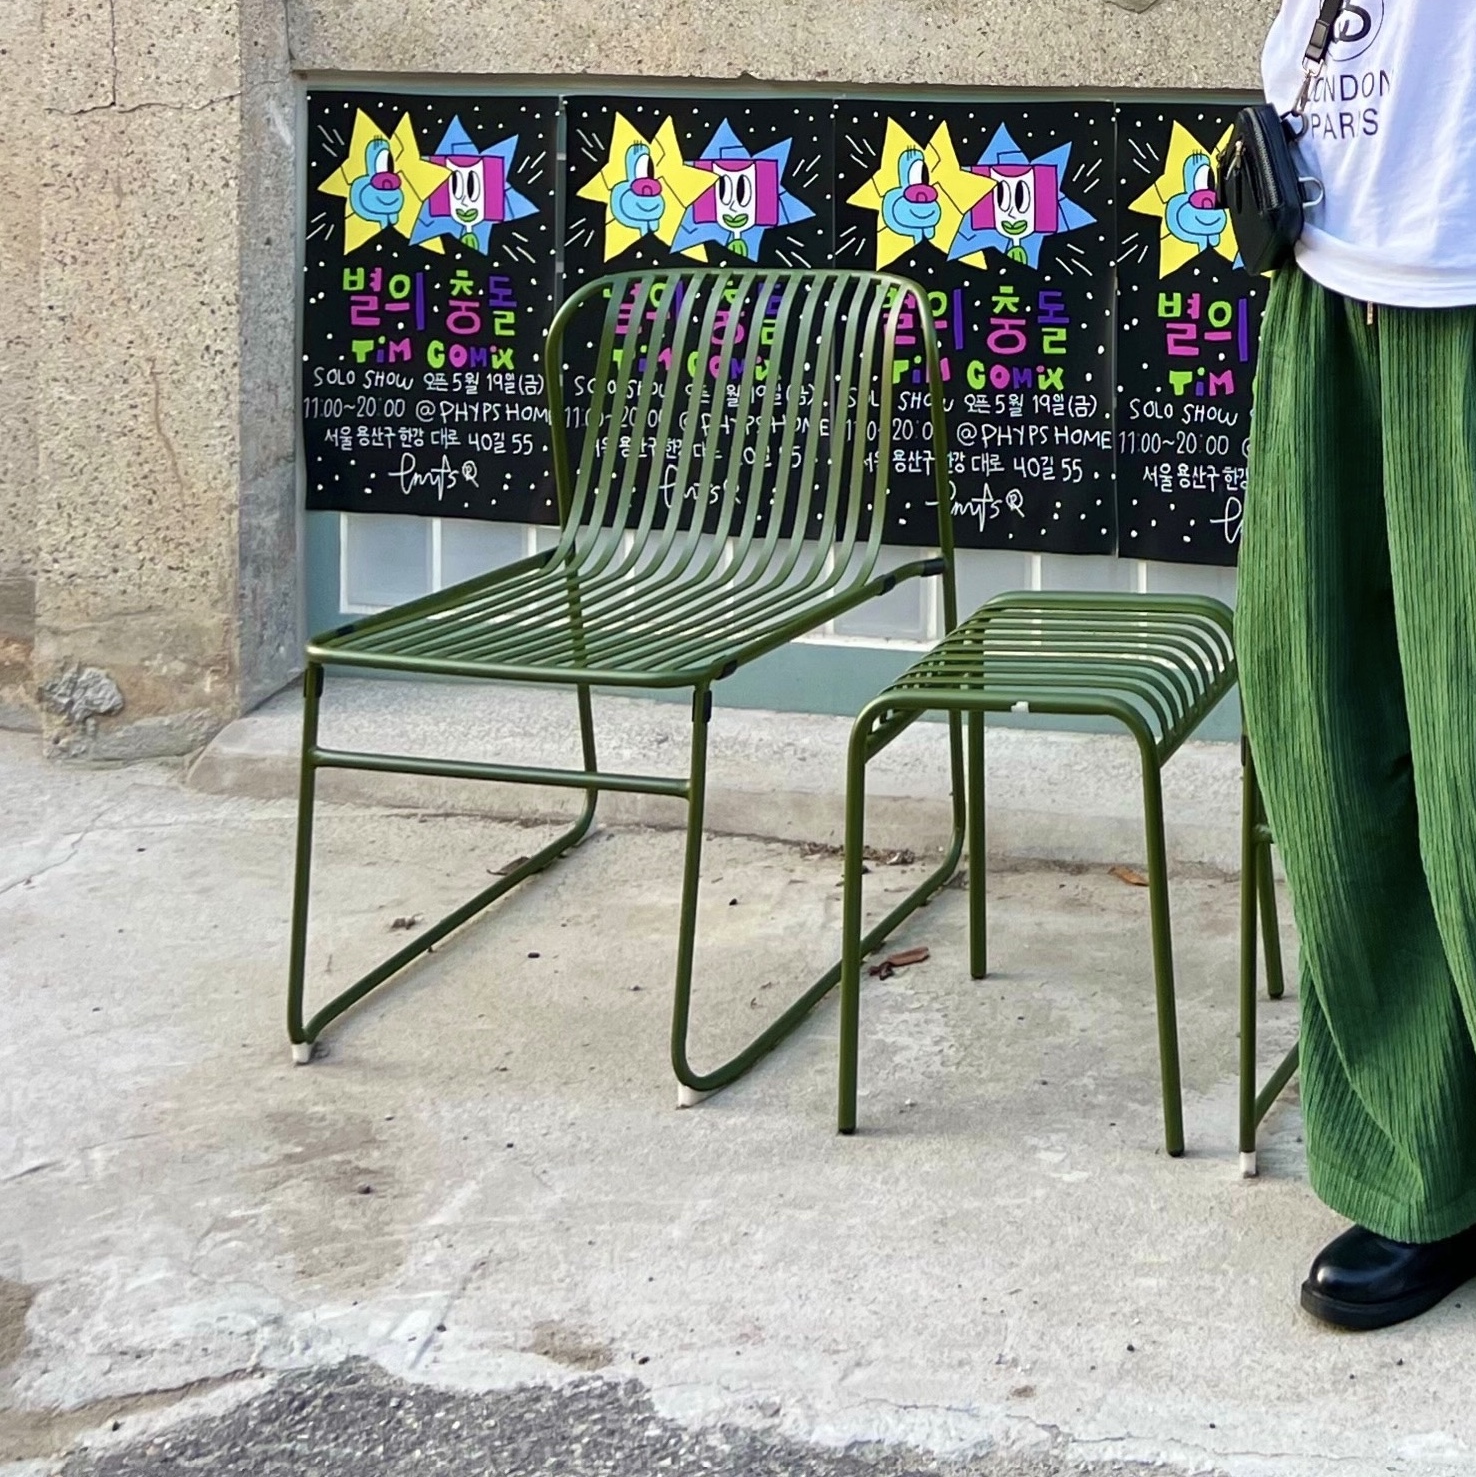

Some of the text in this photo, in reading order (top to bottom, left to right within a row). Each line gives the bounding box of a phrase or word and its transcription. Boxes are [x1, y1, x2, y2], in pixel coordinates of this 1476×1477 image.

[343, 267, 520, 337] 별의 충돌
[987, 286, 1070, 356] 충돌
[1157, 293, 1248, 361] 별의
[313, 364, 354, 385] SOLO
[362, 369, 414, 391] SHOW
[423, 371, 449, 391] 오픈
[485, 371, 546, 396] 19일(금)
[505, 403, 552, 423] HOM
[848, 385, 891, 406] SL
[965, 392, 991, 413] 오픈
[1031, 392, 1098, 418] 19일(금)
[1130, 397, 1238, 426] SOLO SHOW
[325, 426, 356, 451] 서울
[358, 426, 398, 451] 용산구
[468, 432, 507, 454] 40길
[512, 432, 532, 454] 55
[1053, 426, 1115, 448] HOME
[892, 449, 936, 476] 용산구
[1013, 457, 1056, 481] 40길
[1062, 458, 1085, 481] 55
[1142, 464, 1173, 491] 서울
[1176, 464, 1220, 492] 용산구
